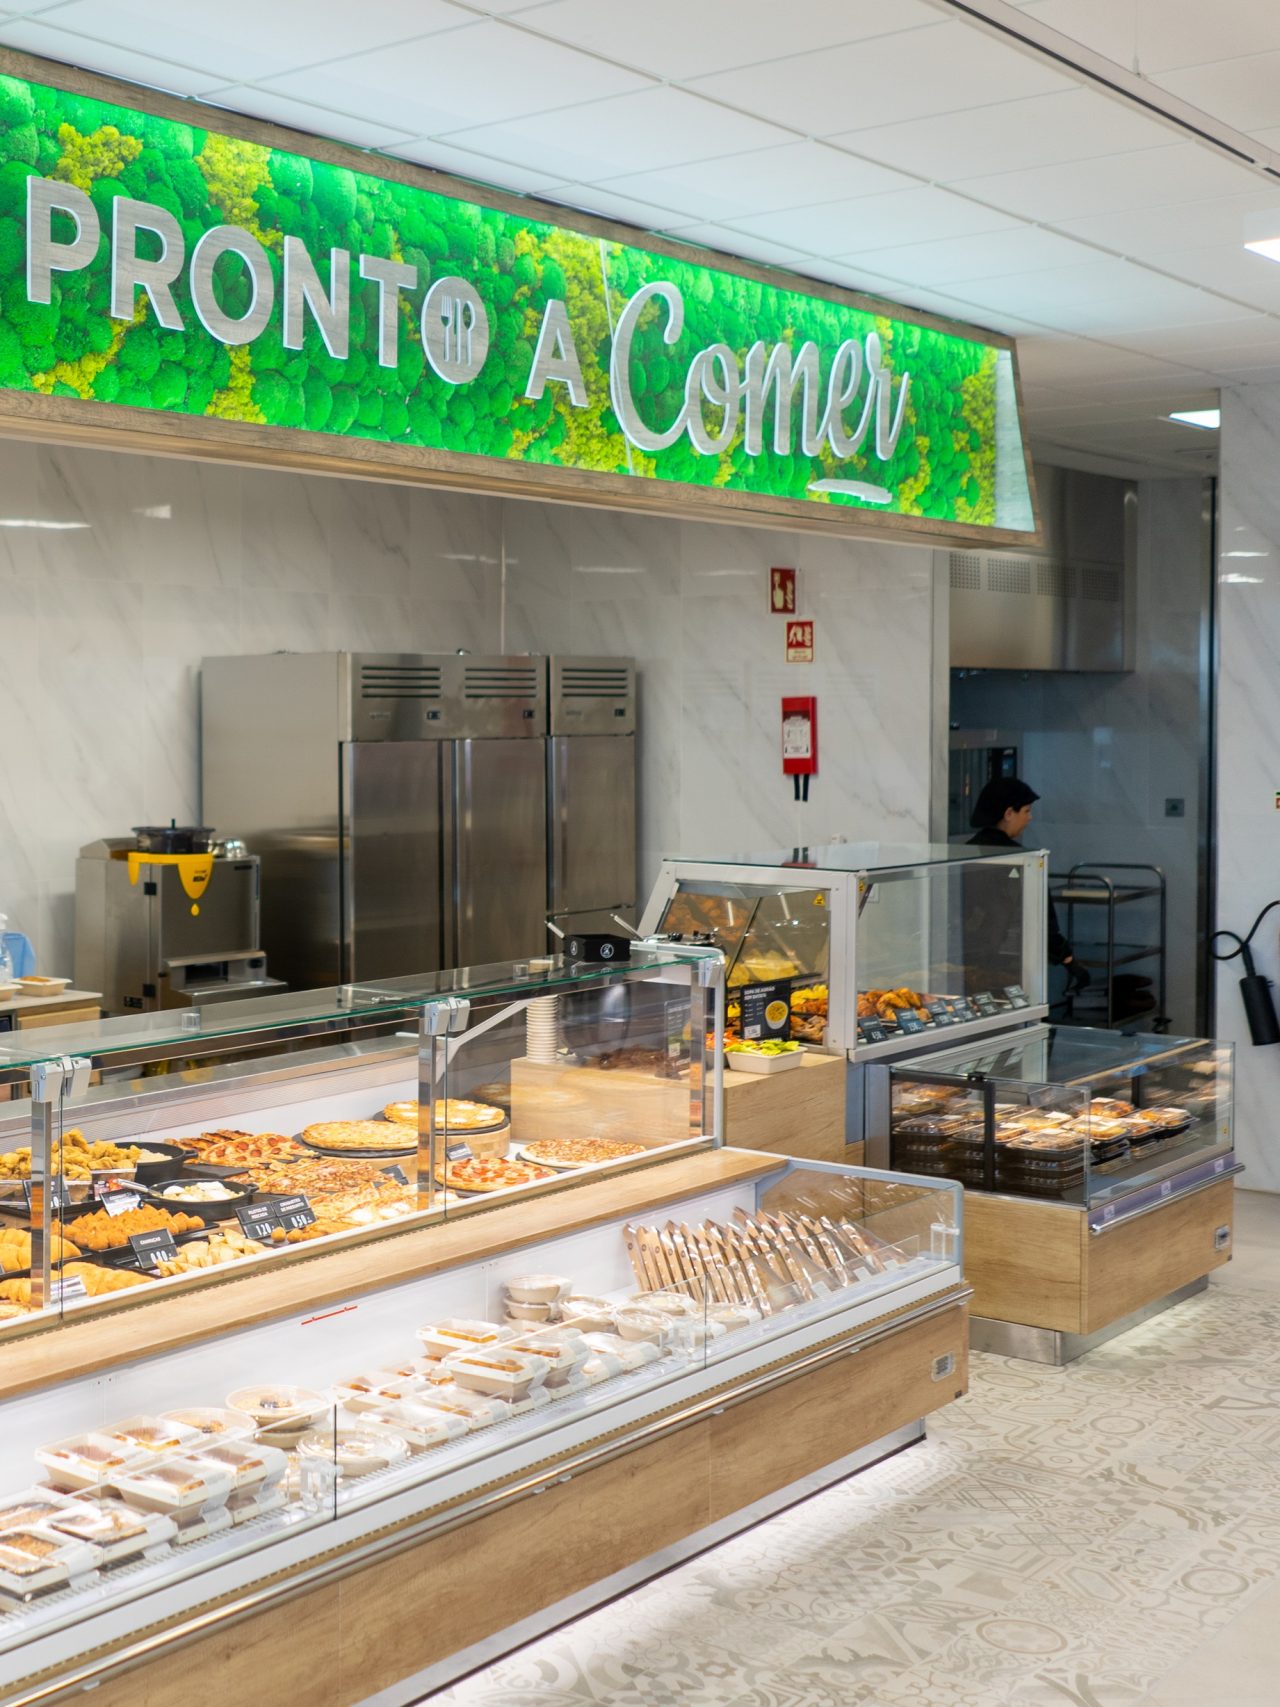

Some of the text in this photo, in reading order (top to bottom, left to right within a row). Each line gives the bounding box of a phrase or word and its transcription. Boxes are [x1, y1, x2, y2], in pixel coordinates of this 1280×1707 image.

[26, 175, 909, 461] PRONTO A Comer
